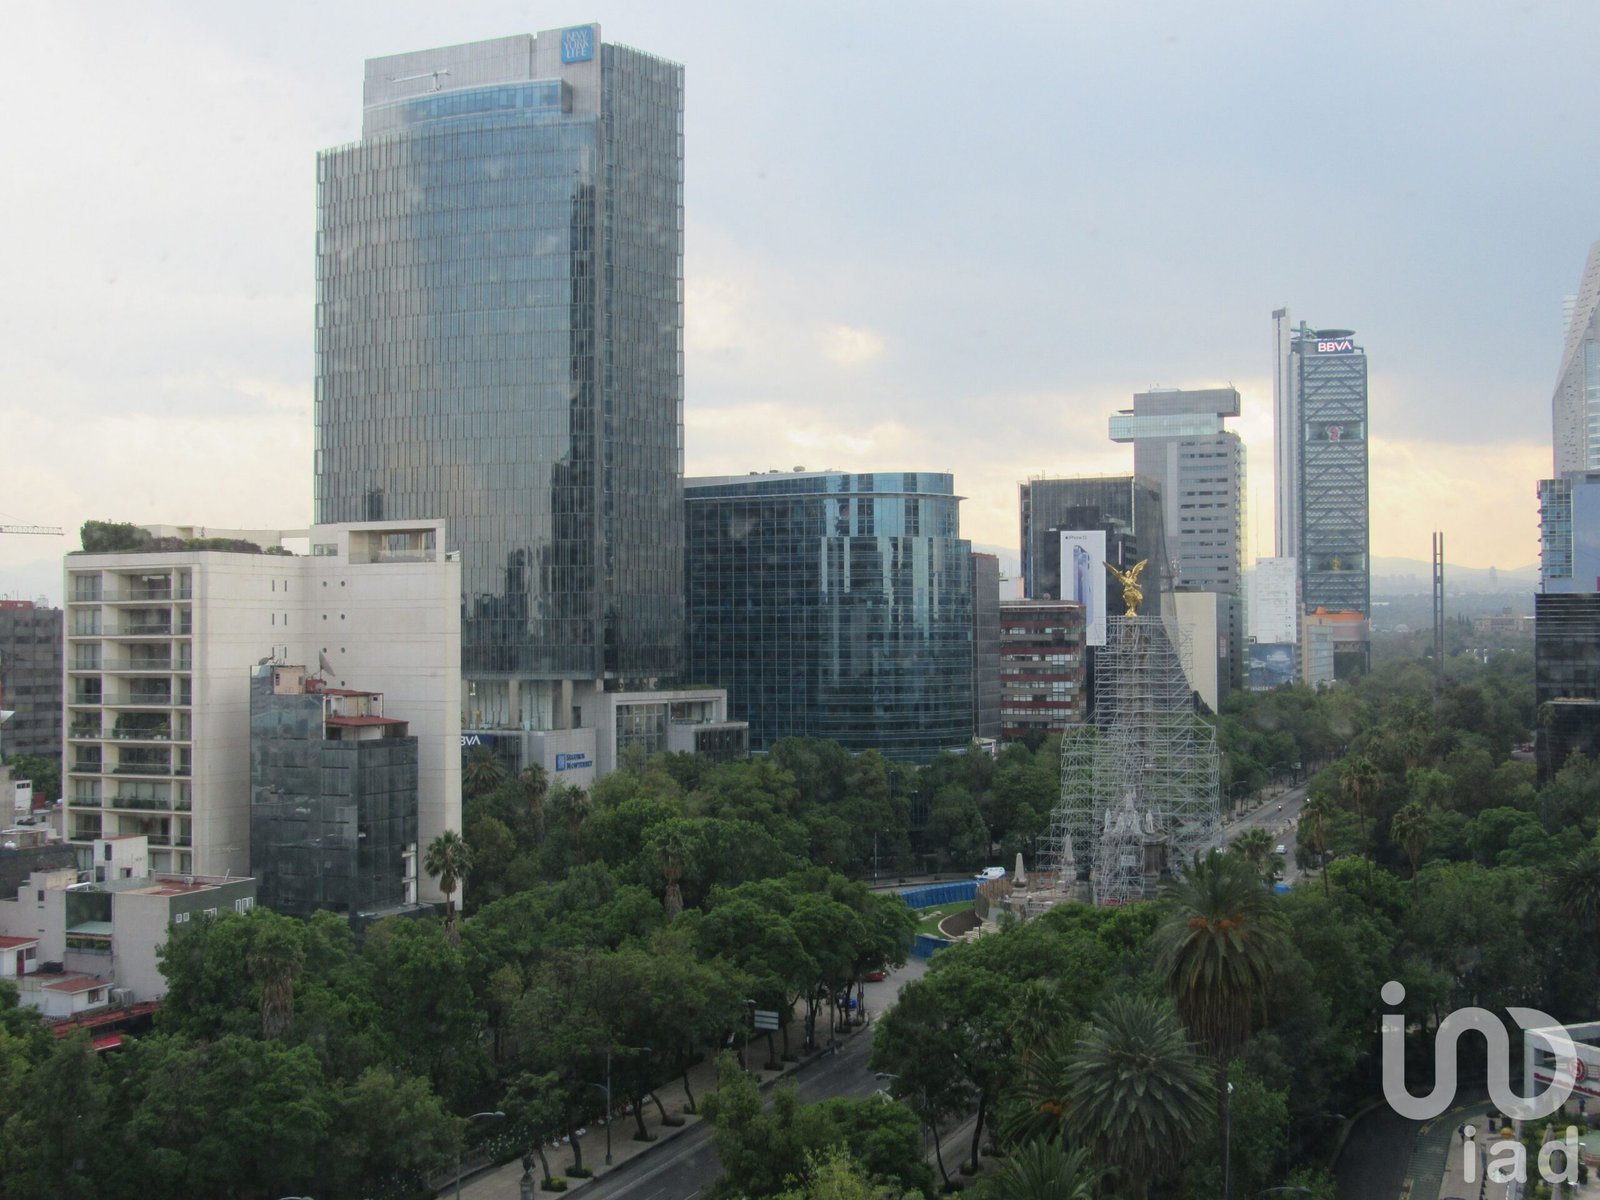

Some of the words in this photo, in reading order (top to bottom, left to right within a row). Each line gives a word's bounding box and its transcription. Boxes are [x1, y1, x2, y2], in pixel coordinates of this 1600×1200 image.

[566, 30, 588, 41] NEW
[563, 39, 589, 49] YORK
[566, 47, 587, 58] LIFE
[1318, 341, 1352, 352] BBVA
[460, 735, 481, 746] BVA
